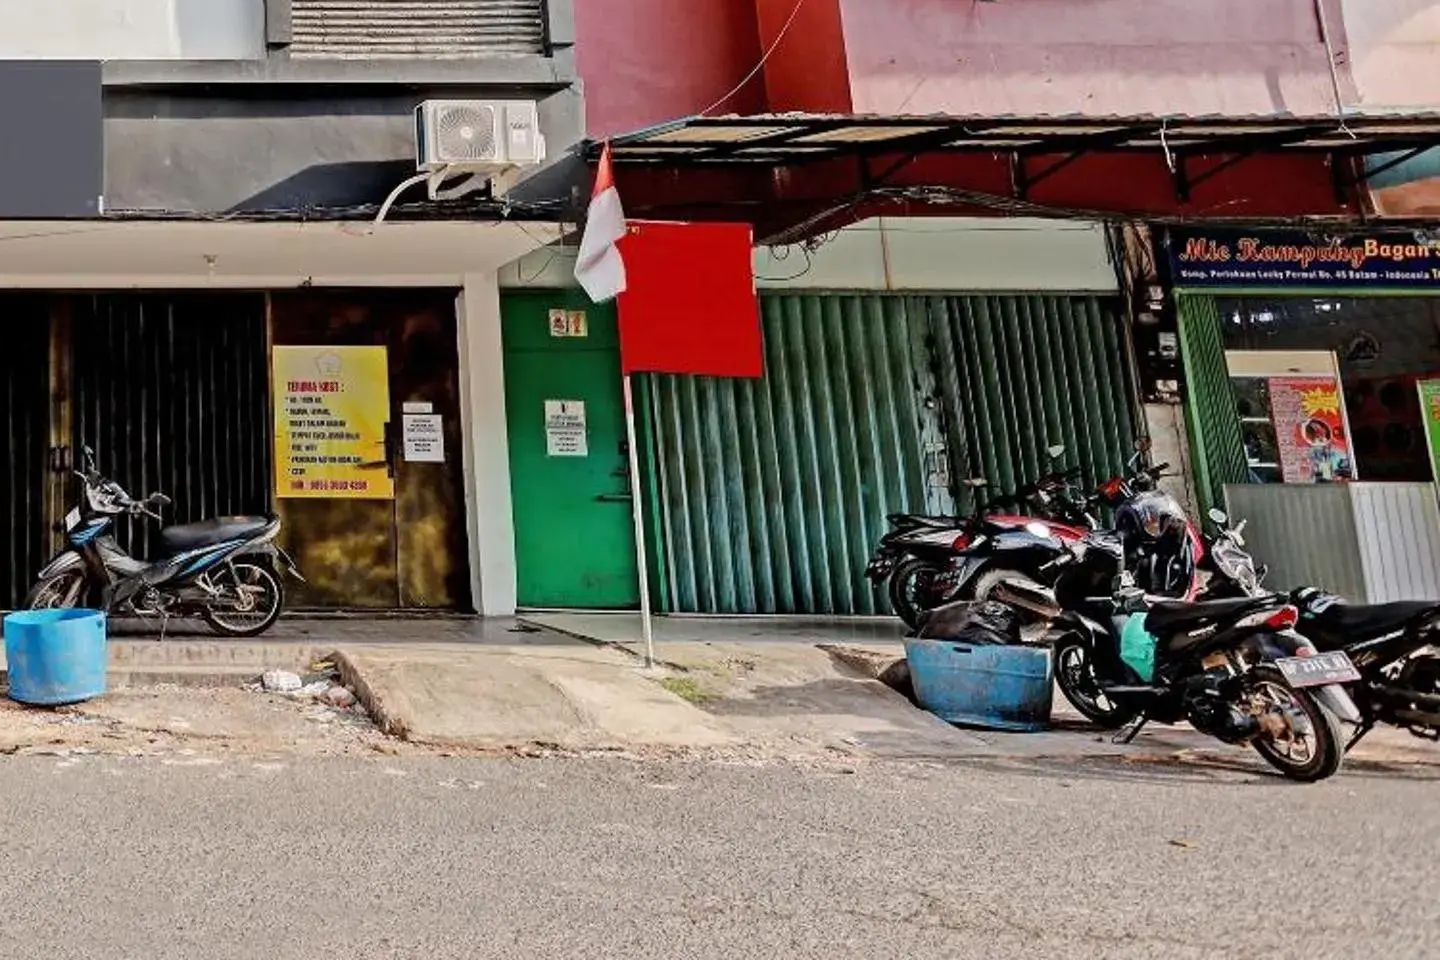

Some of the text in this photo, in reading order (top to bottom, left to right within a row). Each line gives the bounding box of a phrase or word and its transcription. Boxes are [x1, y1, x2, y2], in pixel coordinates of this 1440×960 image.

[1178, 237, 1231, 262] Mie
[1364, 238, 1430, 261] Bagan
[1348, 270, 1378, 280] Batam
